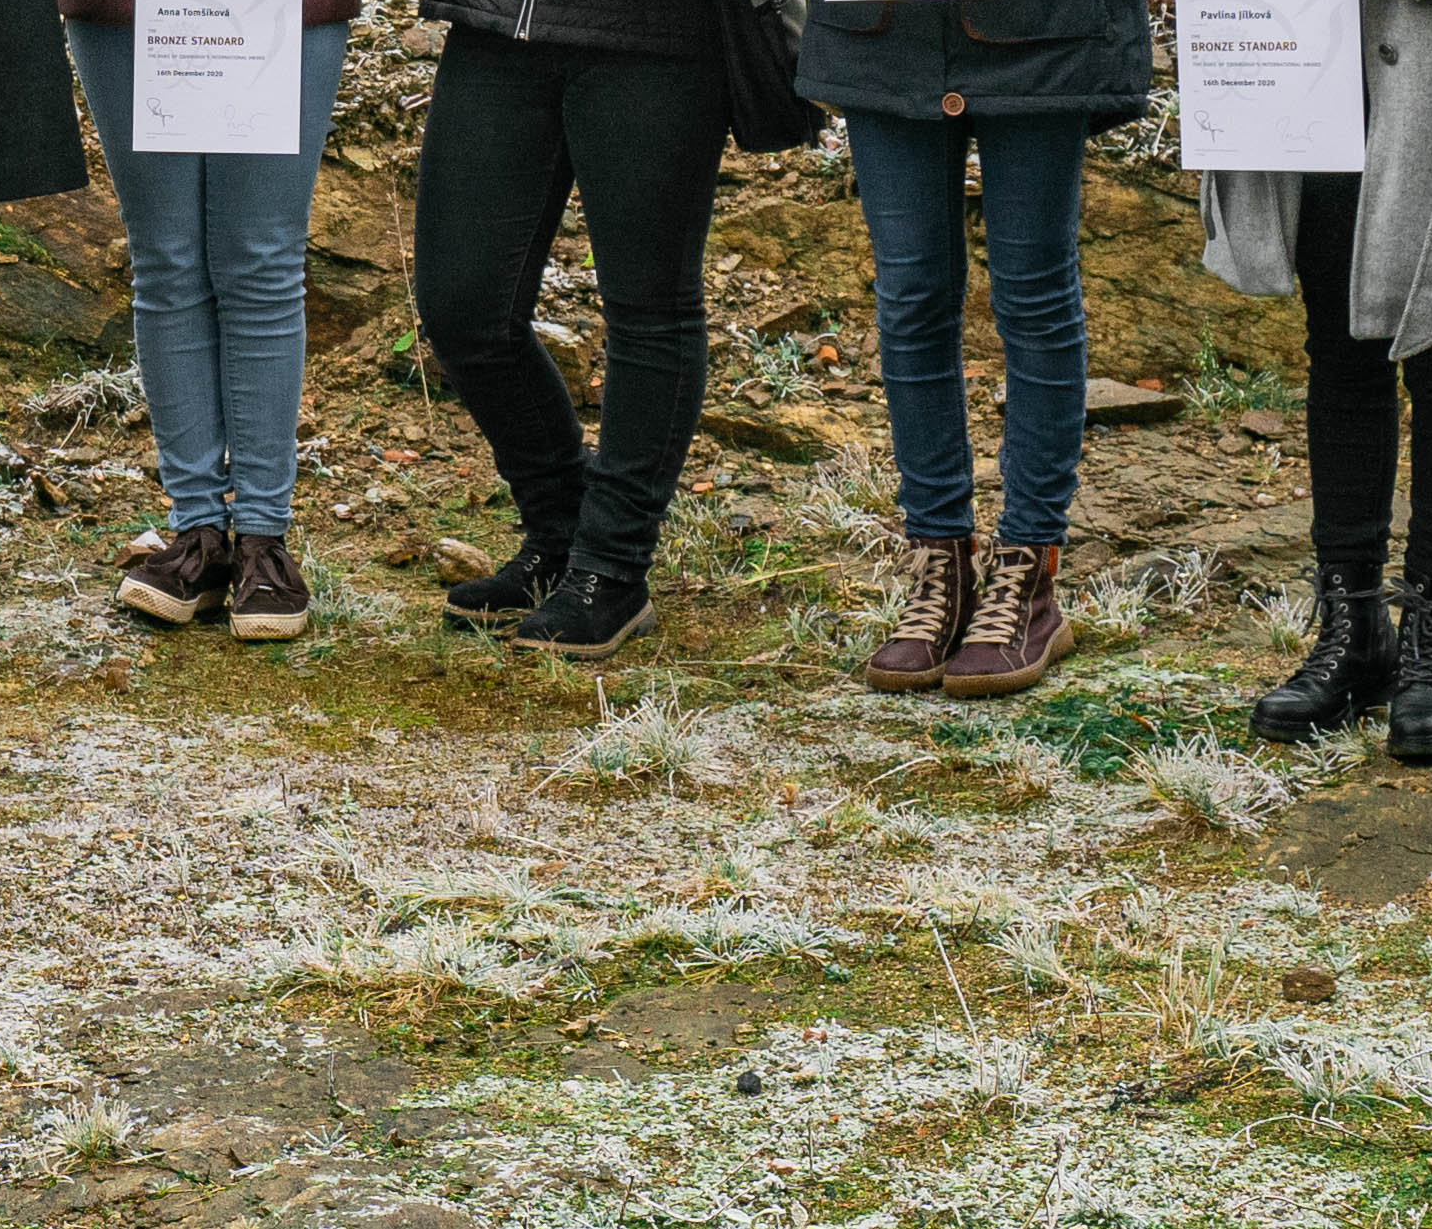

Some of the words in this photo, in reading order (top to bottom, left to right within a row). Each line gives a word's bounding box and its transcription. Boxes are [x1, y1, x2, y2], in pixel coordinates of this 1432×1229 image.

[157, 8, 180, 16] Anna
[183, 8, 230, 17] Tomšíková
[1201, 10, 1236, 20] Pavlína
[148, 36, 187, 45] BRONZE
[191, 37, 244, 45] STANDARD
[1191, 42, 1234, 52] BRONZE
[1239, 41, 1297, 51] STANDARD
